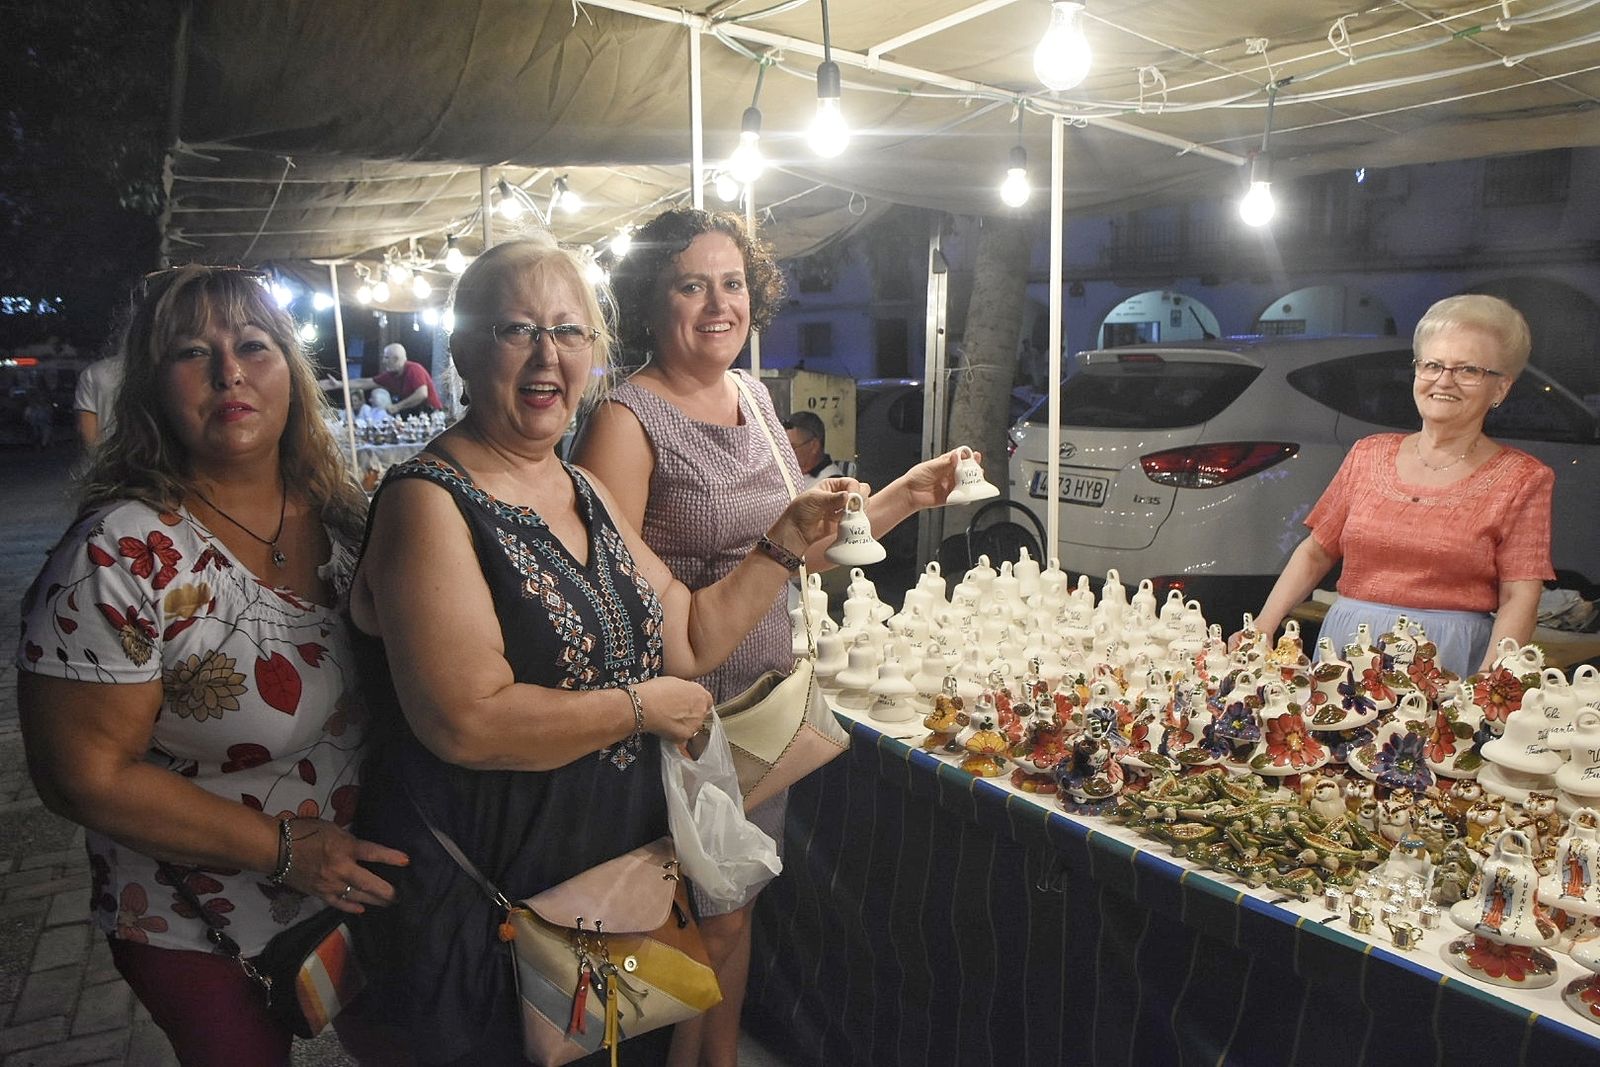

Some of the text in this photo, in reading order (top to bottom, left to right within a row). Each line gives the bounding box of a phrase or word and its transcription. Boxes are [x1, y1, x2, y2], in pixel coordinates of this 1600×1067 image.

[808, 396, 840, 409] 077
[1040, 475, 1103, 500] 473 HYB
